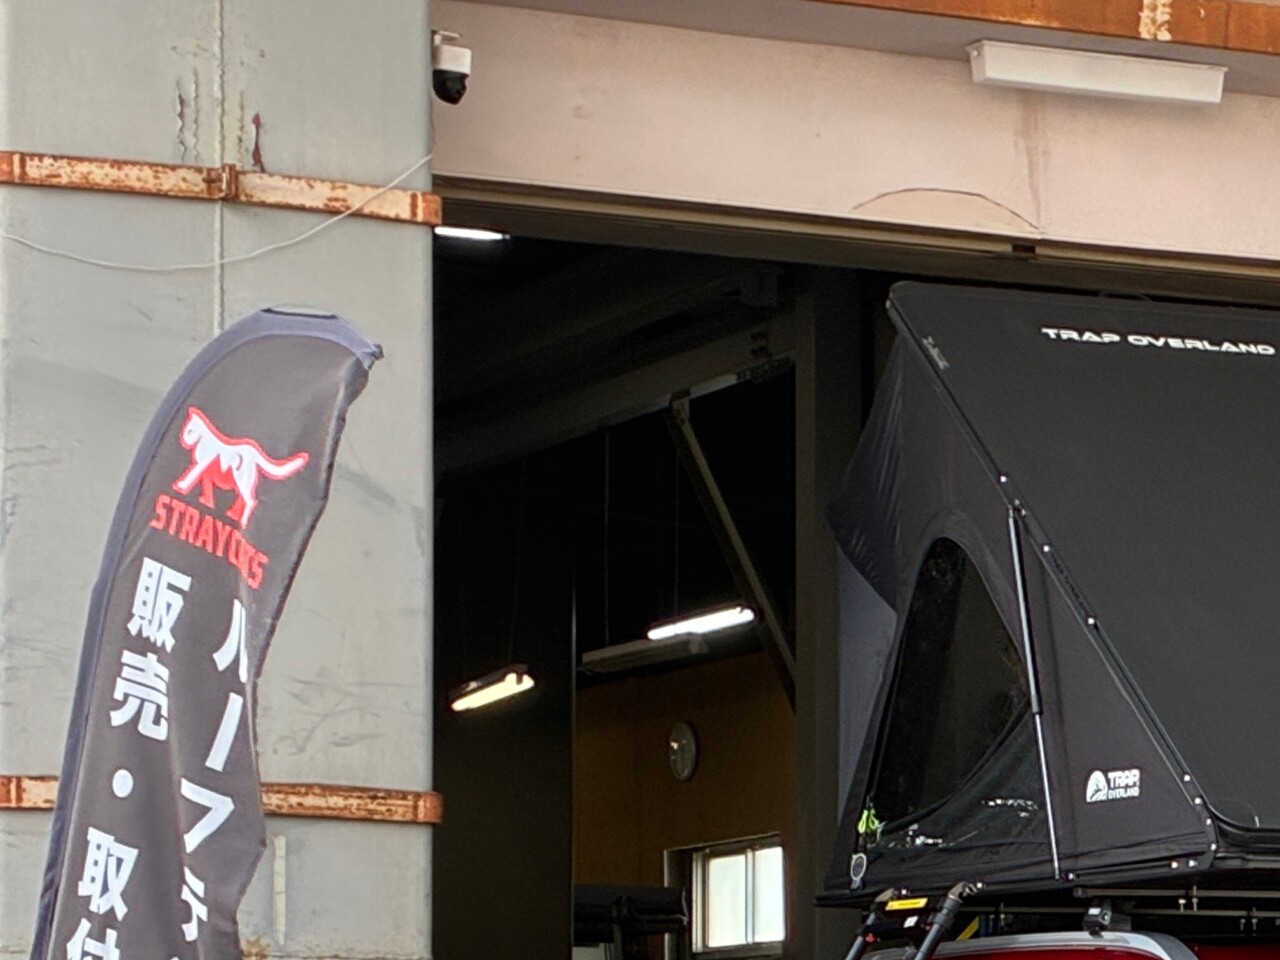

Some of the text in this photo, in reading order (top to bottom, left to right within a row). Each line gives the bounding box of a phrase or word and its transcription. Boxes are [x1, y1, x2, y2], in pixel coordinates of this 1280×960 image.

[1041, 327, 1276, 355] TRAP OVERLAND
[1107, 769, 1141, 788] TRAP
